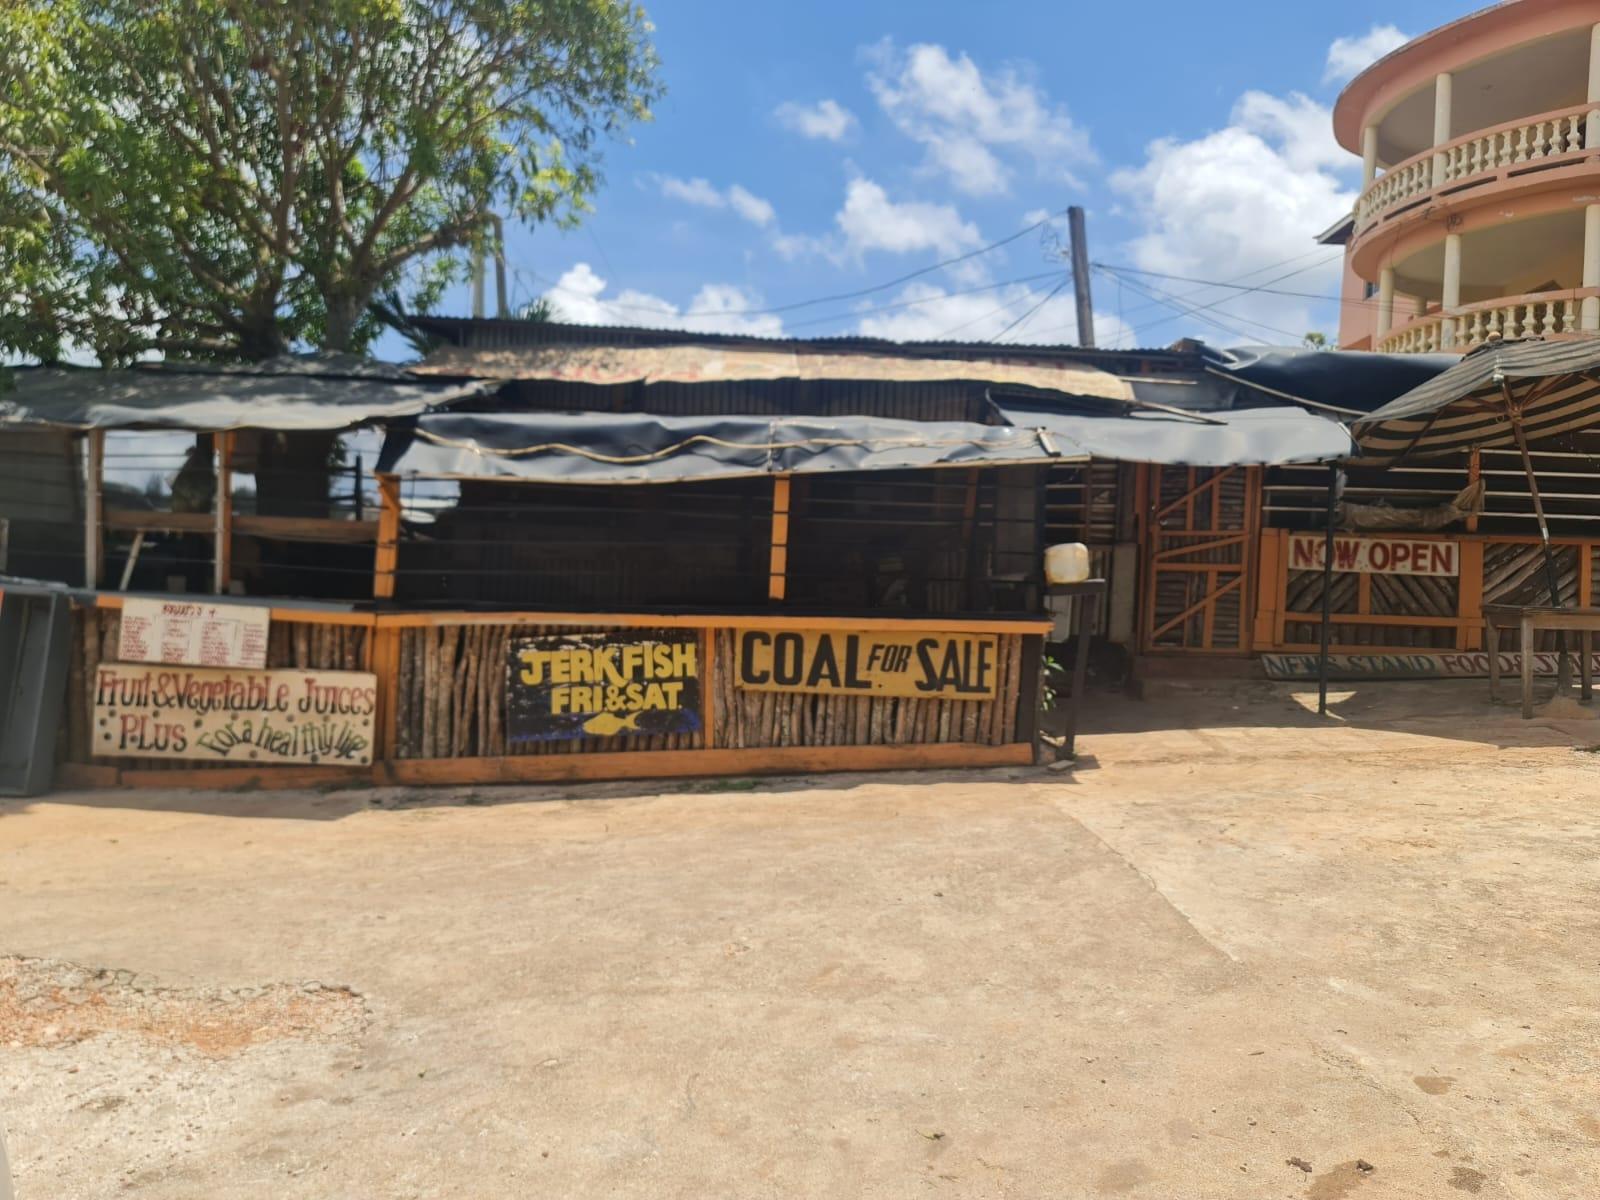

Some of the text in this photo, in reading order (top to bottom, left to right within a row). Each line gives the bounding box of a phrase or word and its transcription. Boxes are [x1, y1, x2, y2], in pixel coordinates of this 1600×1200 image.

[1293, 538, 1453, 573] NOW OPEN
[520, 642, 697, 688] JERK FISH
[741, 631, 993, 693] COAL FOR SALE
[1347, 654, 1436, 674] STAND
